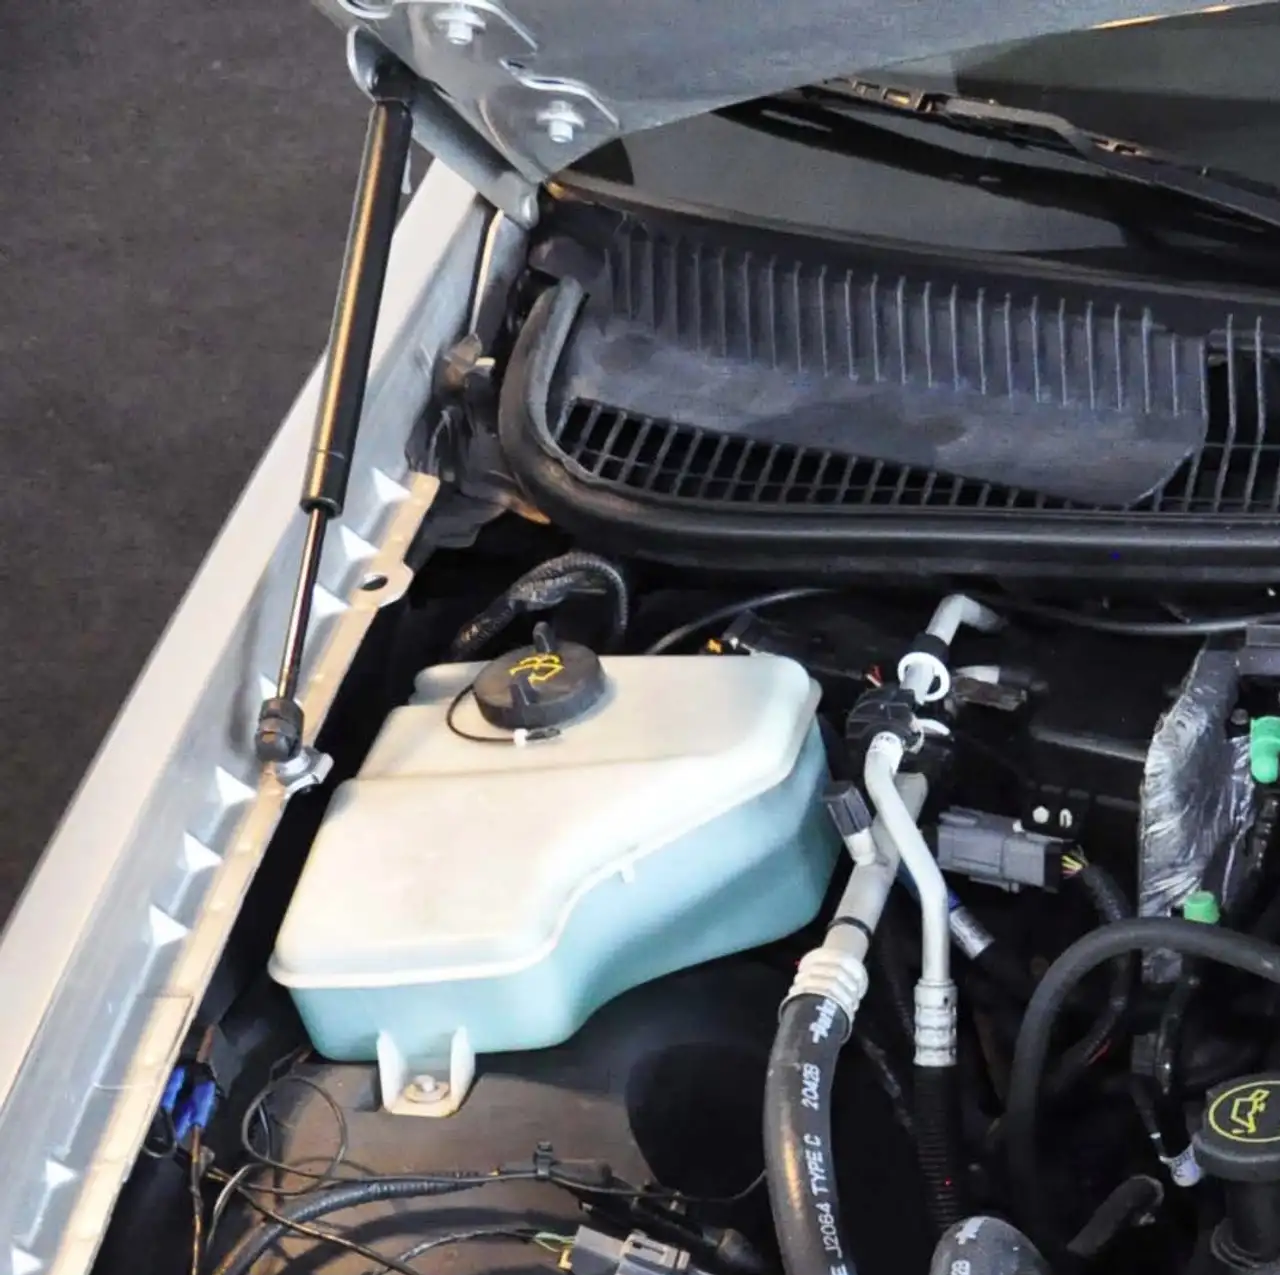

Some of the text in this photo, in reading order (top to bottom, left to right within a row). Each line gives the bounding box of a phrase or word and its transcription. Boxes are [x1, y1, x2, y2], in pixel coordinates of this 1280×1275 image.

[808, 999, 837, 1043] Parke
[802, 1132, 821, 1148] C
[805, 1150, 828, 1196] TYPE
